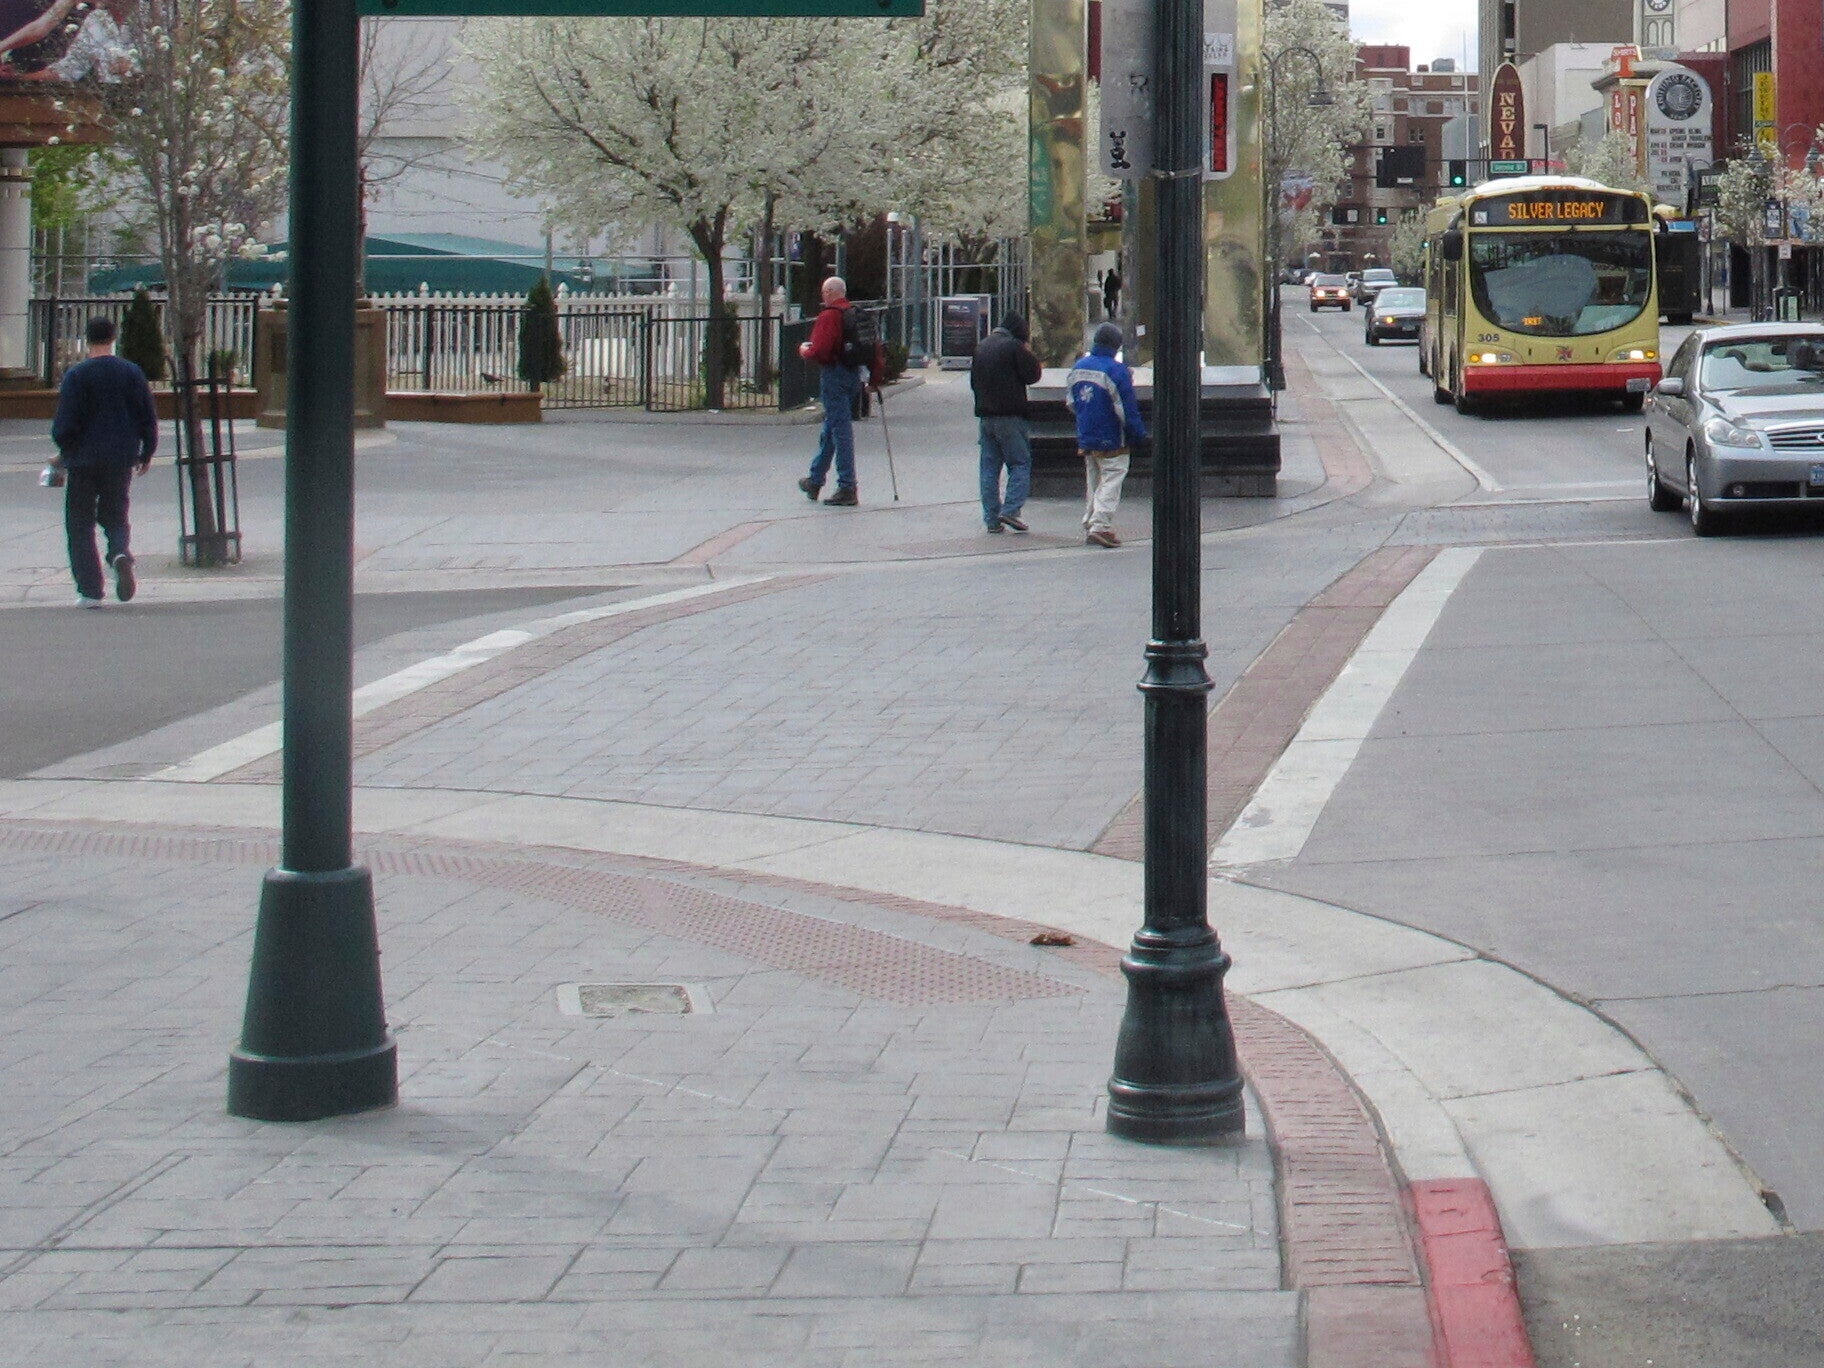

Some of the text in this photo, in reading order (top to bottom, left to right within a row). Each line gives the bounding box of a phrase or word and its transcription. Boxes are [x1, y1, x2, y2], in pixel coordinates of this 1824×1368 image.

[1508, 201, 1605, 219] SILVER LEGACY
[1478, 334, 1500, 343] 305
